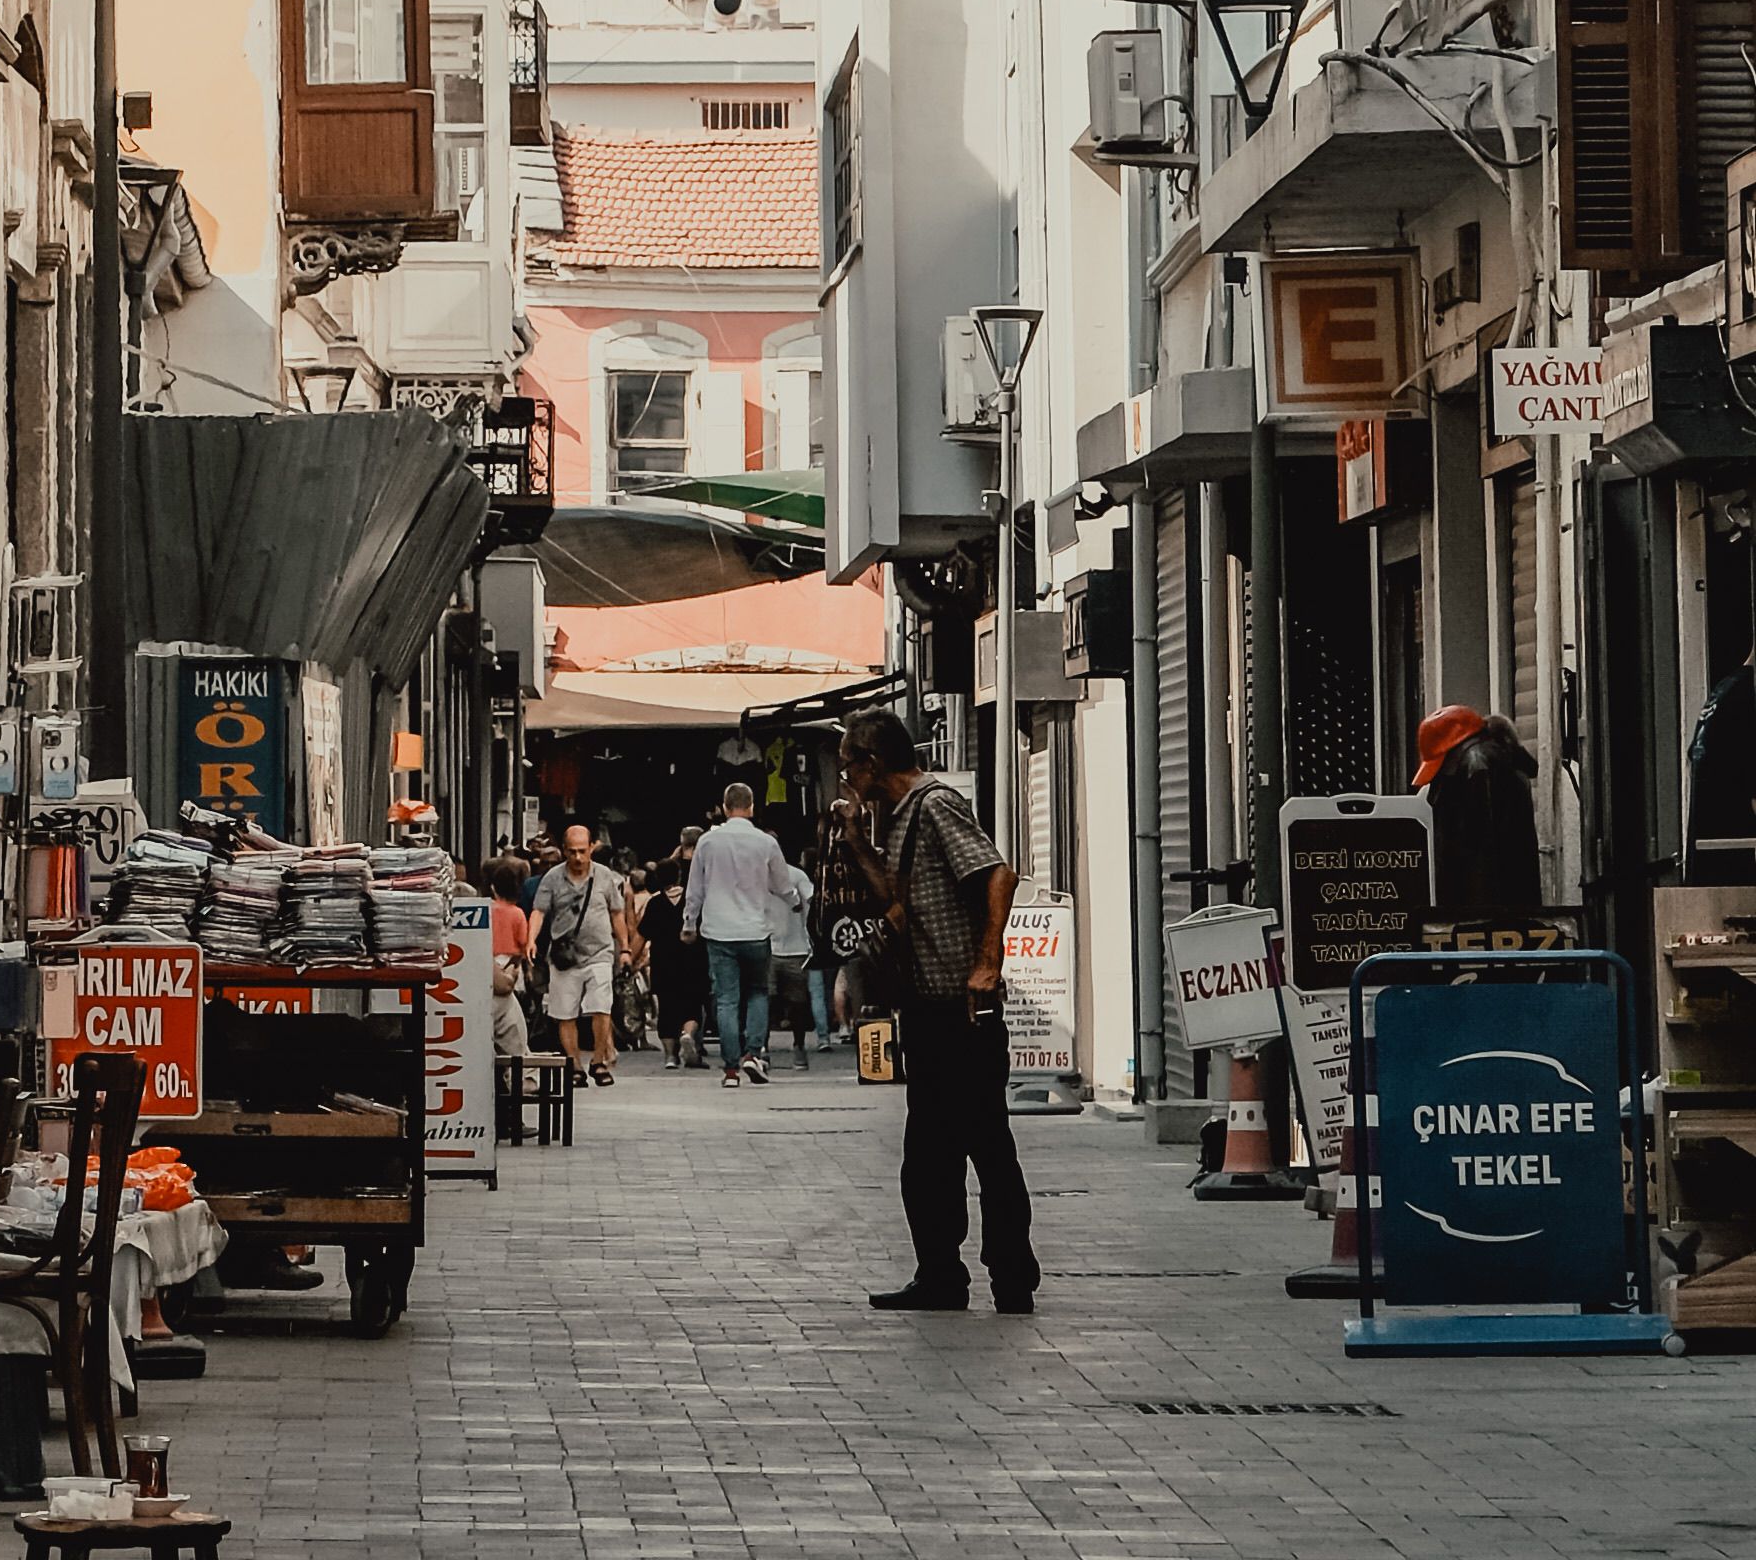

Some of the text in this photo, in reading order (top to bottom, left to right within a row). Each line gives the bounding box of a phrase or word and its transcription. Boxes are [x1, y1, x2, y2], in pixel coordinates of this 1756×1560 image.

[1300, 286, 1384, 384] E
[194, 665, 268, 697] HAKİKİ
[195, 701, 266, 822] ÖR
[1295, 849, 1422, 869] DERİ MONT
[1321, 882, 1399, 903] ÇANTA
[1312, 910, 1408, 931] TADİLAT
[85, 1007, 162, 1046] CAM
[1016, 1052, 1069, 1067] 710 07 65
[1414, 1102, 1595, 1143] ÇINAR EFE
[1451, 1154, 1562, 1186] TEKEL
